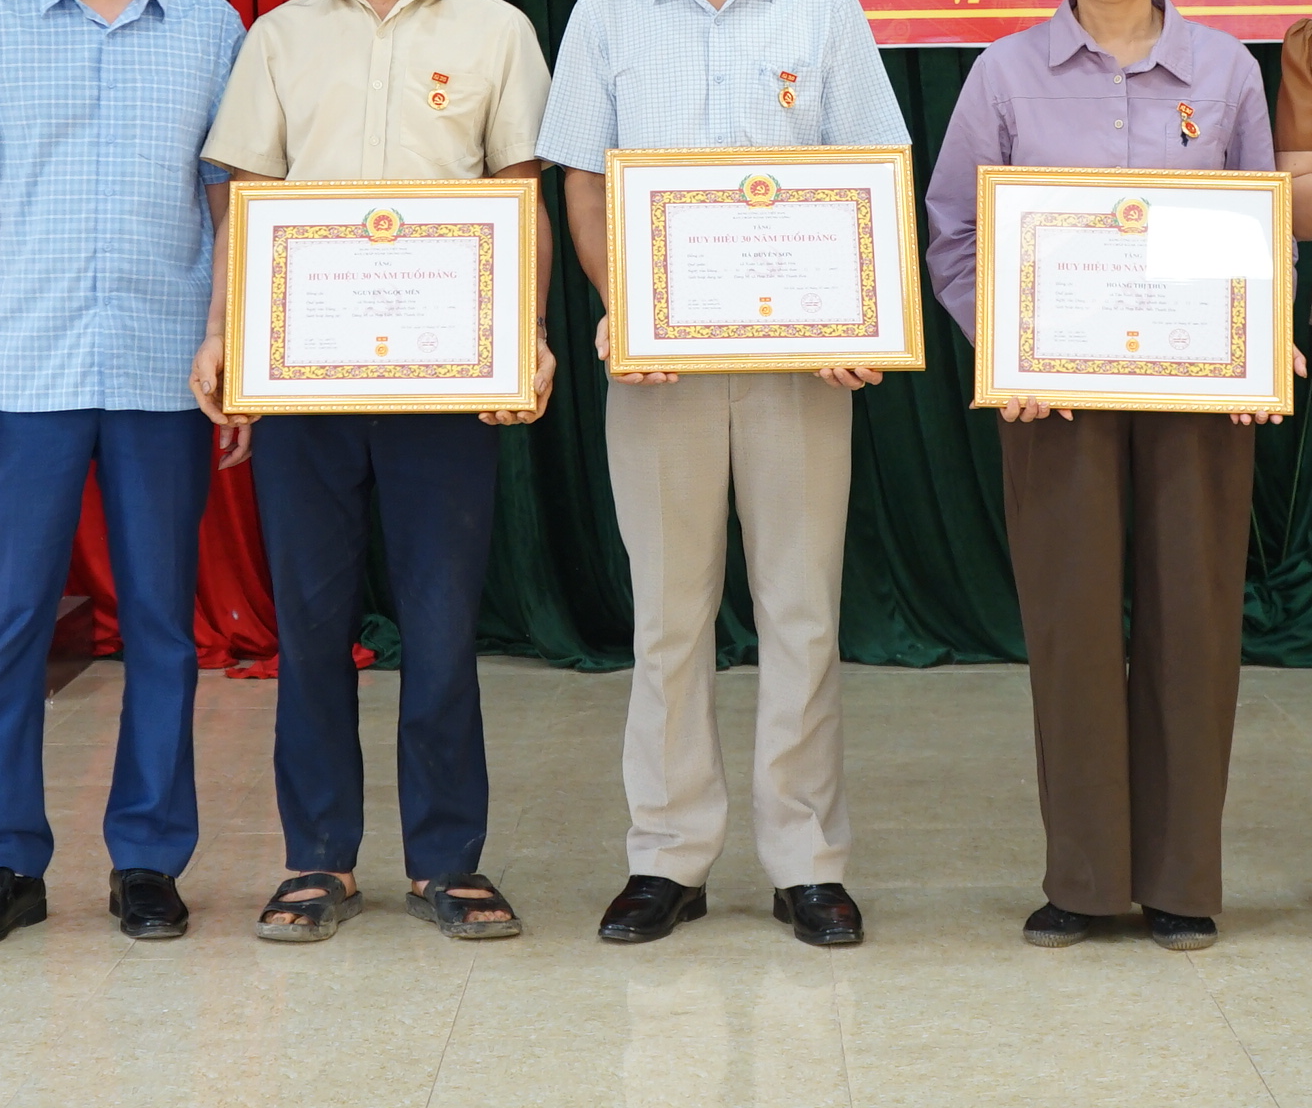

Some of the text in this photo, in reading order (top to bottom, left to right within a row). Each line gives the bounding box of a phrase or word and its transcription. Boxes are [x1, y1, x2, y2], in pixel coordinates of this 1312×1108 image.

[741, 235, 752, 243] 30
[1057, 262, 1080, 271] HUY
[1111, 263, 1122, 272] 30
[308, 273, 330, 281] HUY
[361, 272, 372, 280] 30
